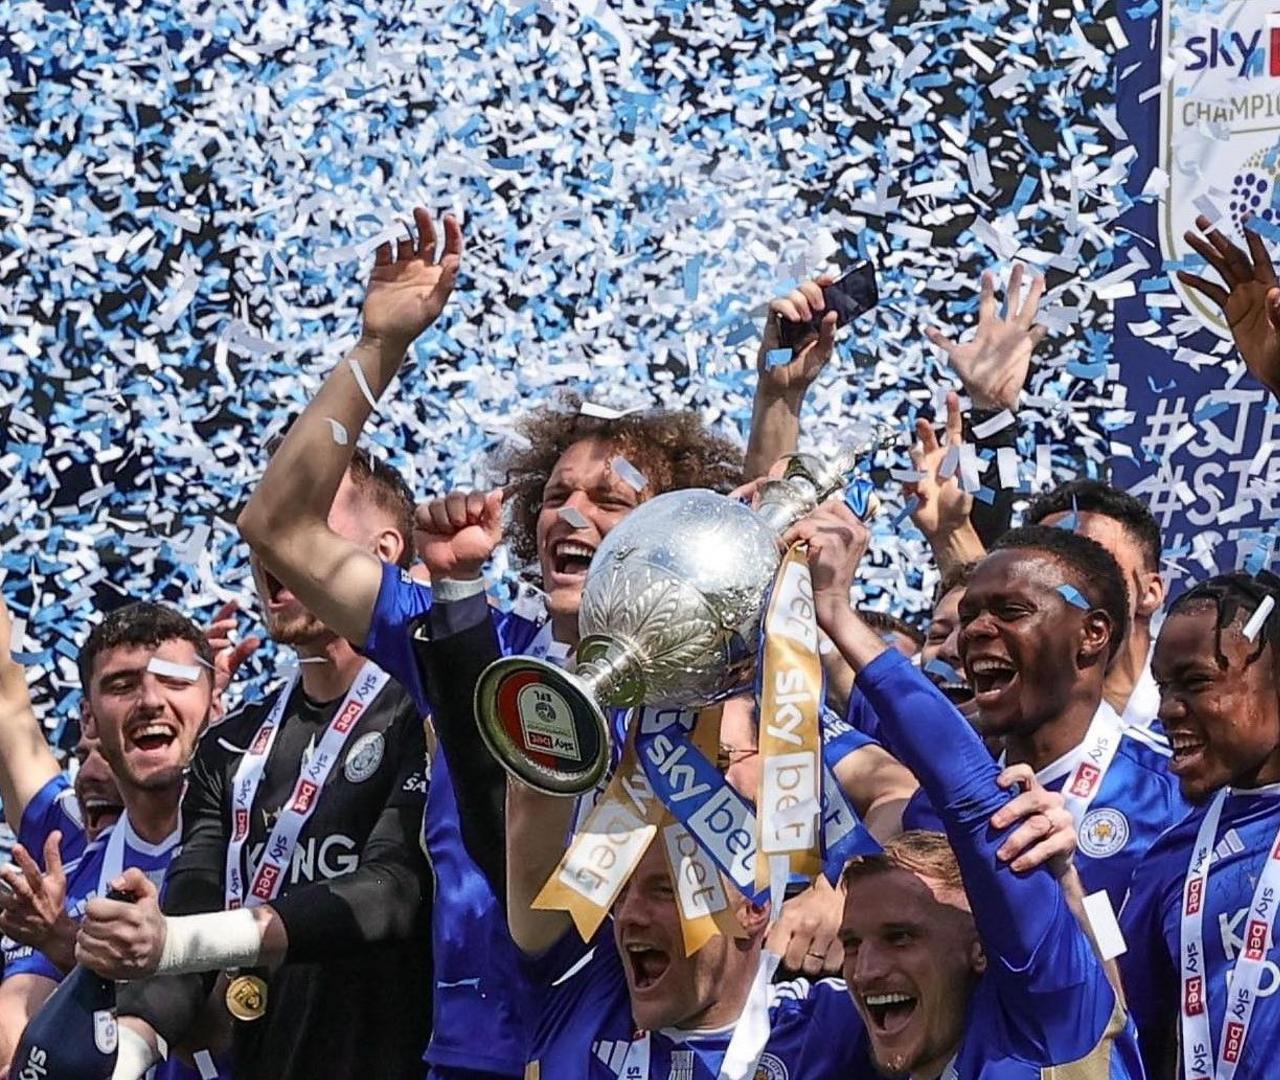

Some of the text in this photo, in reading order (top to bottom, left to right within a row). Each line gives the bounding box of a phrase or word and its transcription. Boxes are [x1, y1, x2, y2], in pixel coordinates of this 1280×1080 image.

[1184, 23, 1260, 77] sky
[336, 674, 377, 731] sky bet
[767, 672, 814, 745] sky
[294, 754, 328, 811] sky bet
[647, 734, 711, 802] sky
[1072, 737, 1109, 794] sky bet
[255, 835, 287, 896] sky bet
[577, 816, 633, 891] bet
[675, 832, 718, 908] bet
[1188, 881, 1203, 913] bet
[1246, 886, 1273, 958] sky bet
[1186, 943, 1204, 1014] sky bet
[1225, 988, 1250, 1061] sky bet
[1194, 1044, 1205, 1078] sky
